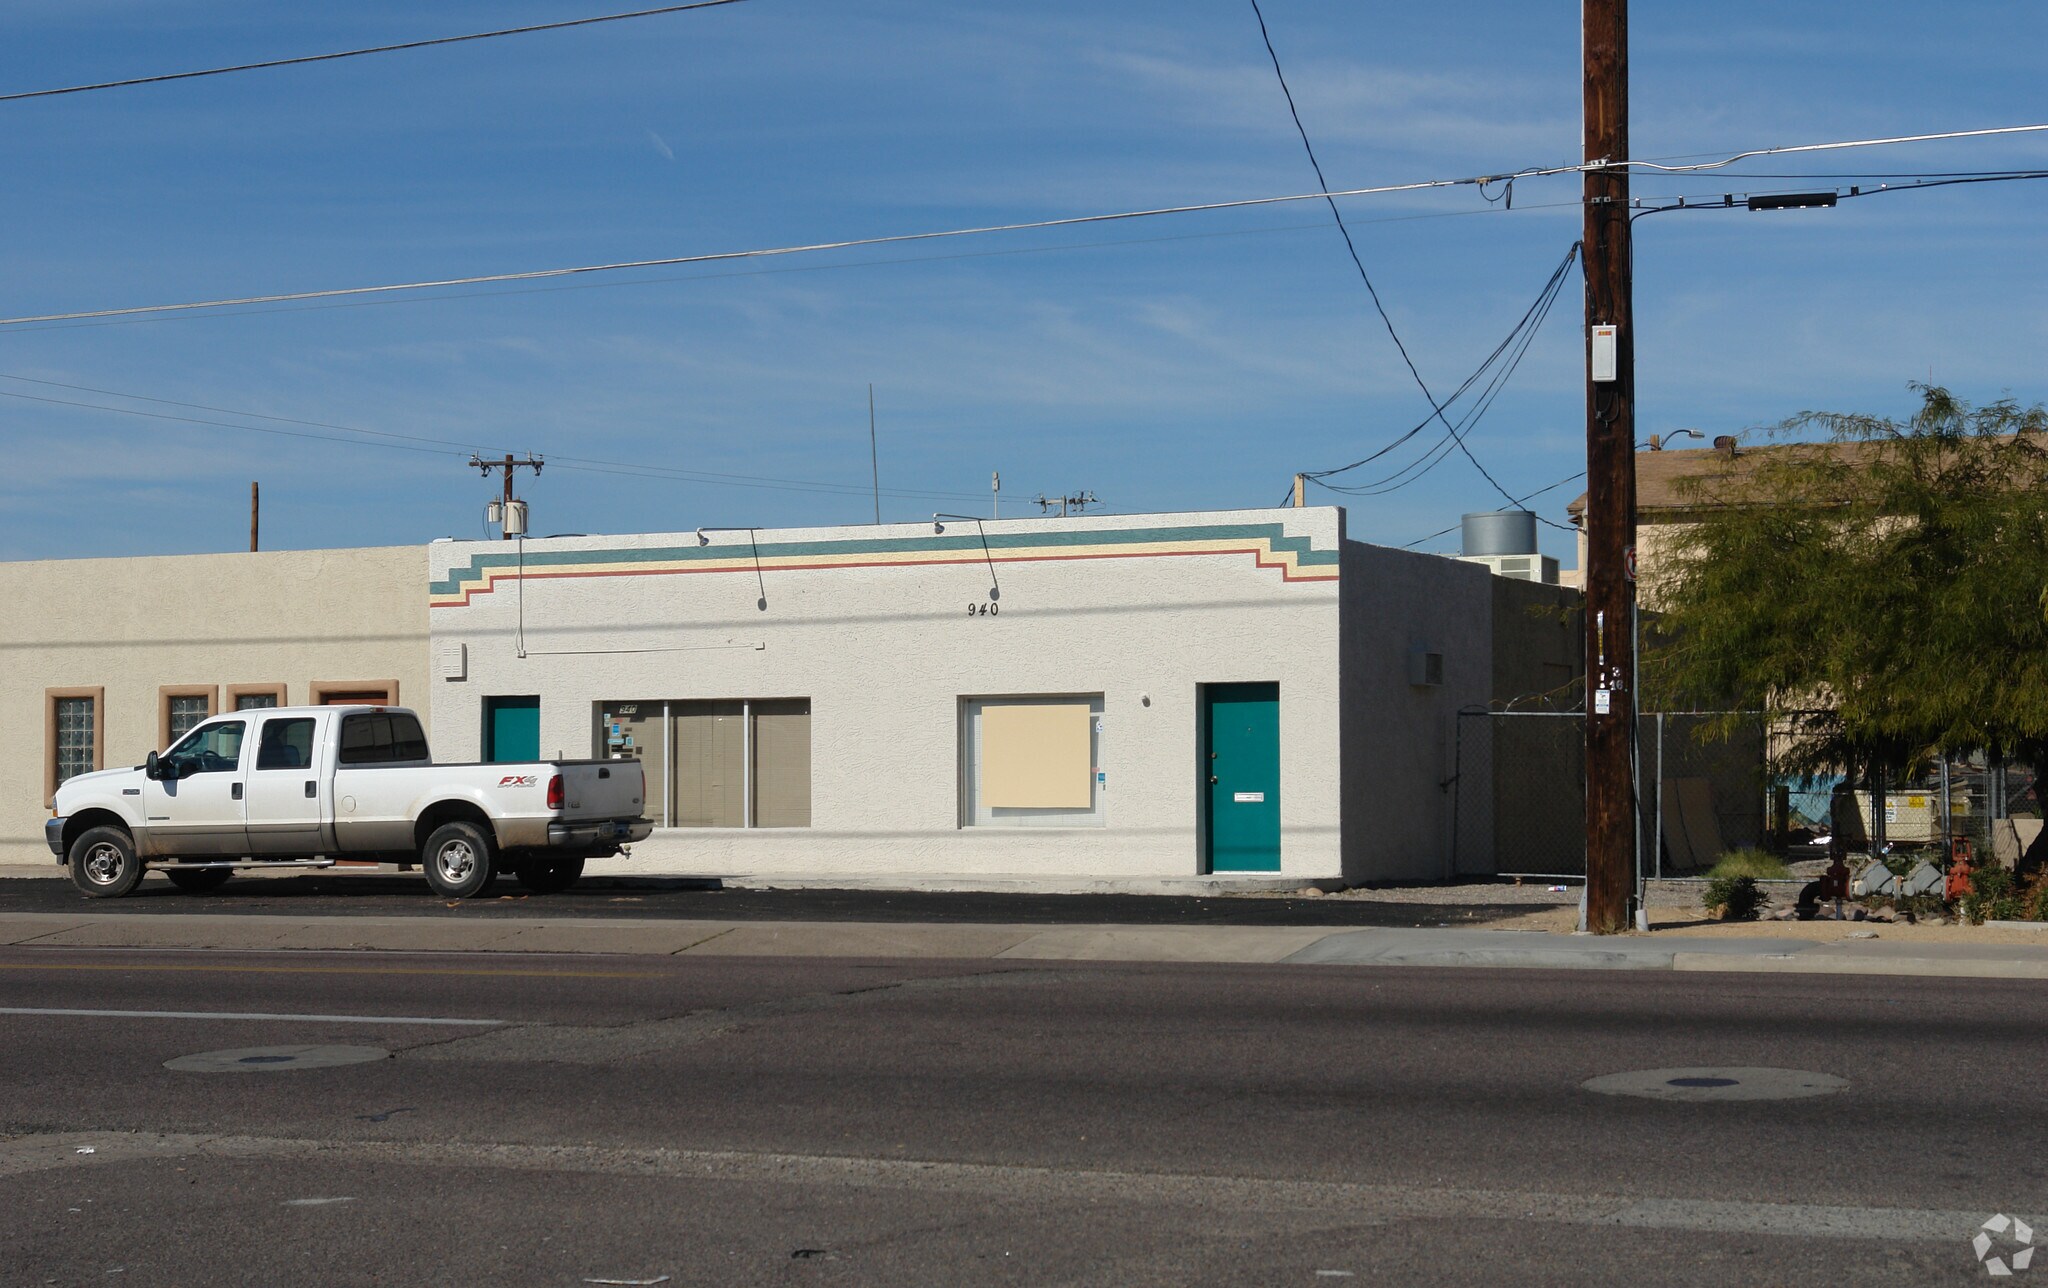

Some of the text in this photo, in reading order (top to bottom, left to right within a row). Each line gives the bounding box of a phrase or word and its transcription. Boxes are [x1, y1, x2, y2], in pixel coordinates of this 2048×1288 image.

[968, 602, 999, 616] 940
[619, 704, 637, 714] 940
[498, 775, 538, 785] FX4
